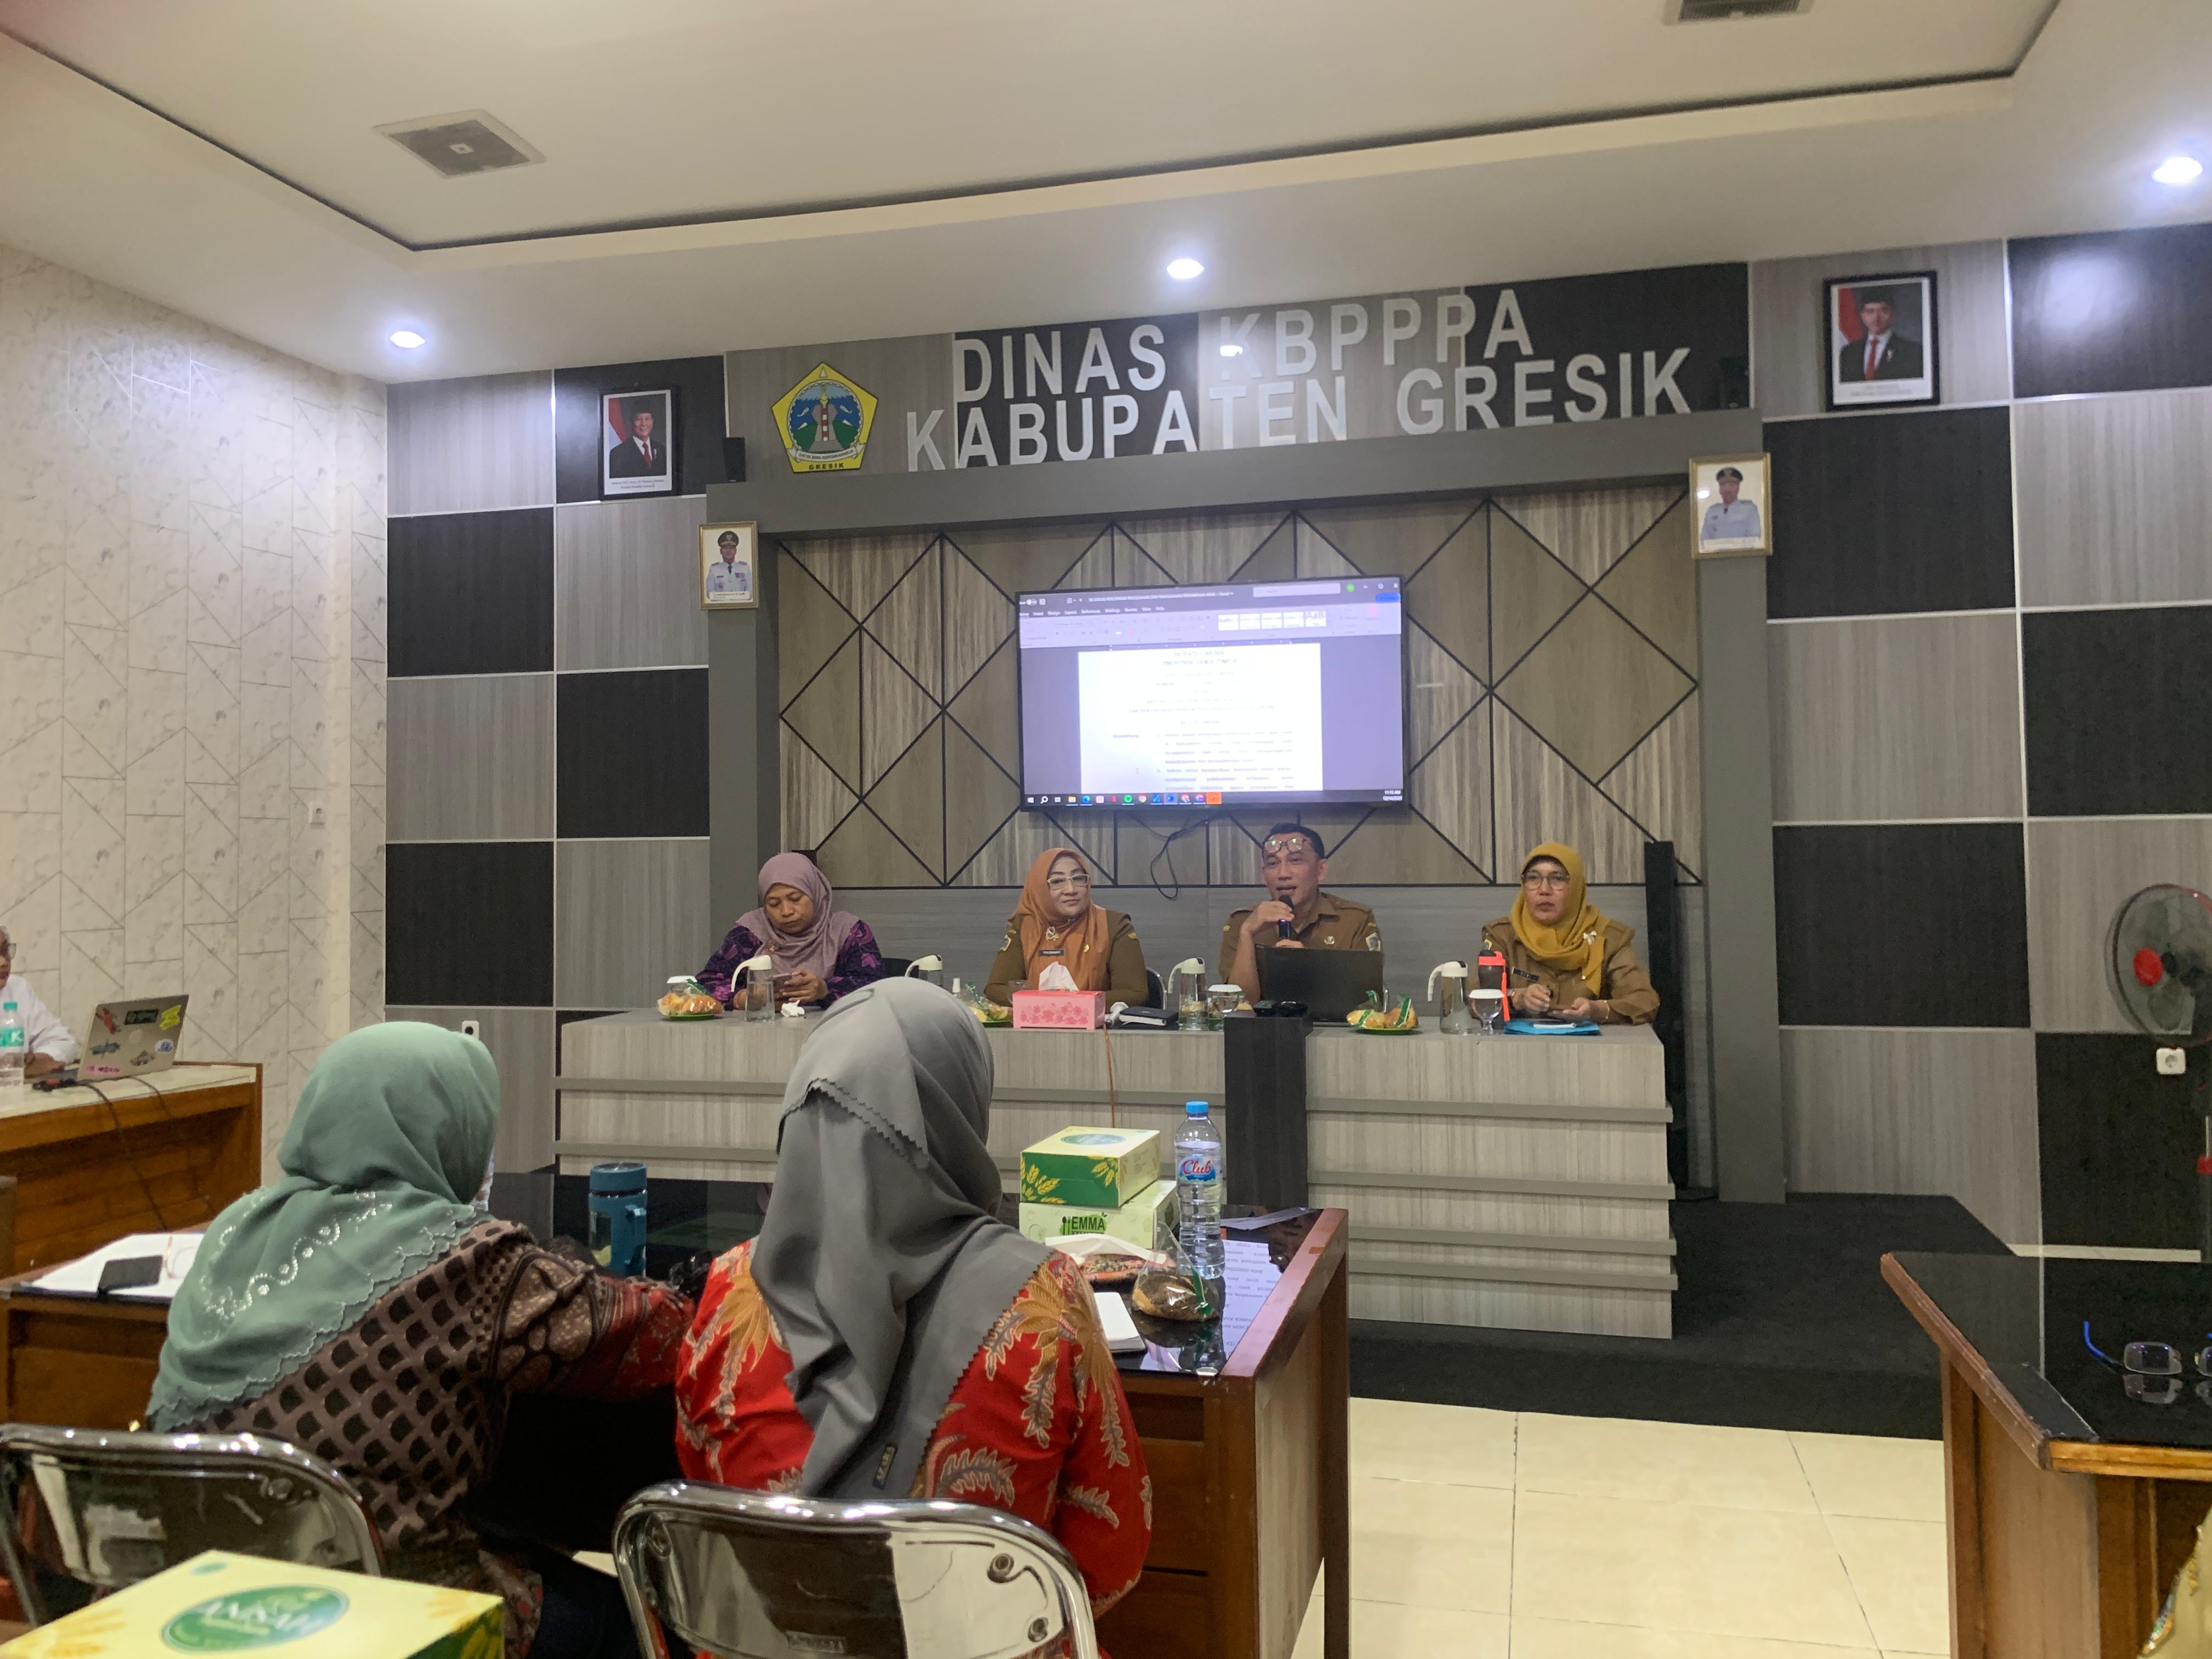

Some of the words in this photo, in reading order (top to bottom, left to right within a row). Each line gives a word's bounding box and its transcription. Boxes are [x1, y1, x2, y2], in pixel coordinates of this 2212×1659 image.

[953, 324, 1166, 402] DINAS
[1218, 289, 1534, 382] KBPPPA
[907, 375, 1347, 472] KABUPATEN
[1396, 347, 1691, 436] GRESIK
[1182, 1159, 1212, 1175] Club
[1071, 1216, 1105, 1231] EMMA
